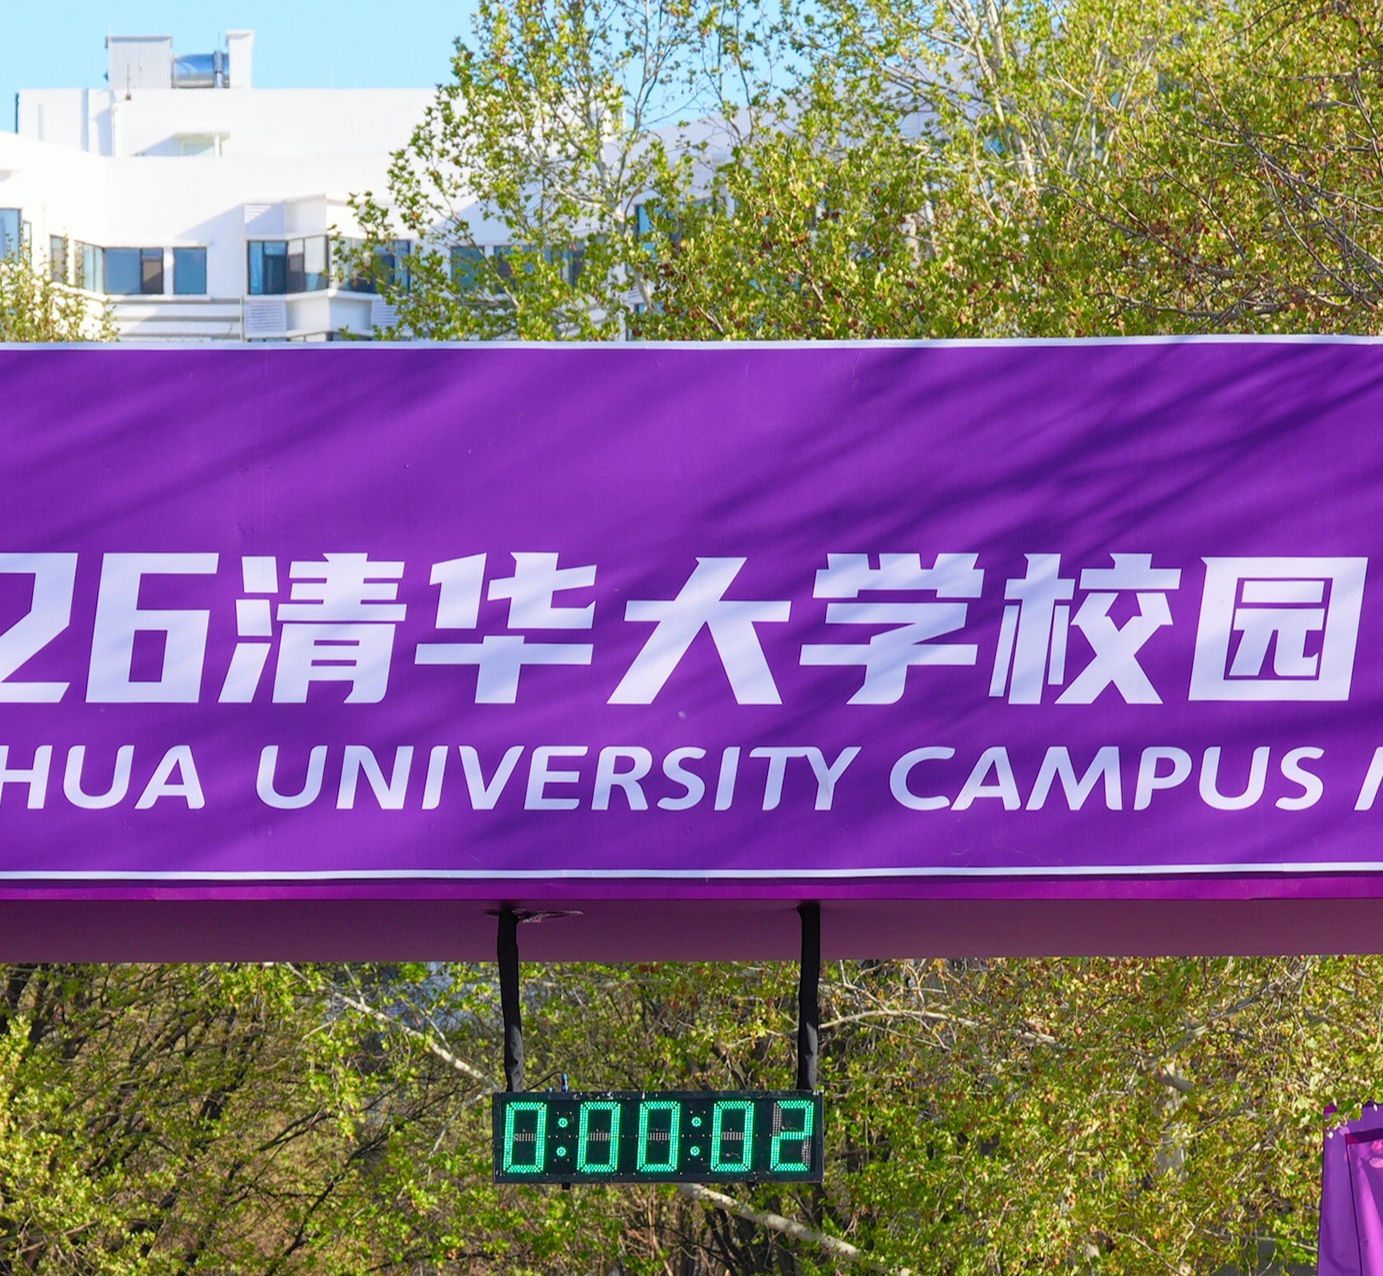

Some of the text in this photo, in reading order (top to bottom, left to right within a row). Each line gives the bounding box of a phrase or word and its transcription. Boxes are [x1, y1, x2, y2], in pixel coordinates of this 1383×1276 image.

[256, 744, 862, 811] UNIVERSITY
[888, 744, 1324, 811] CAMPUS
[503, 1100, 815, 1174] 0:00:02
